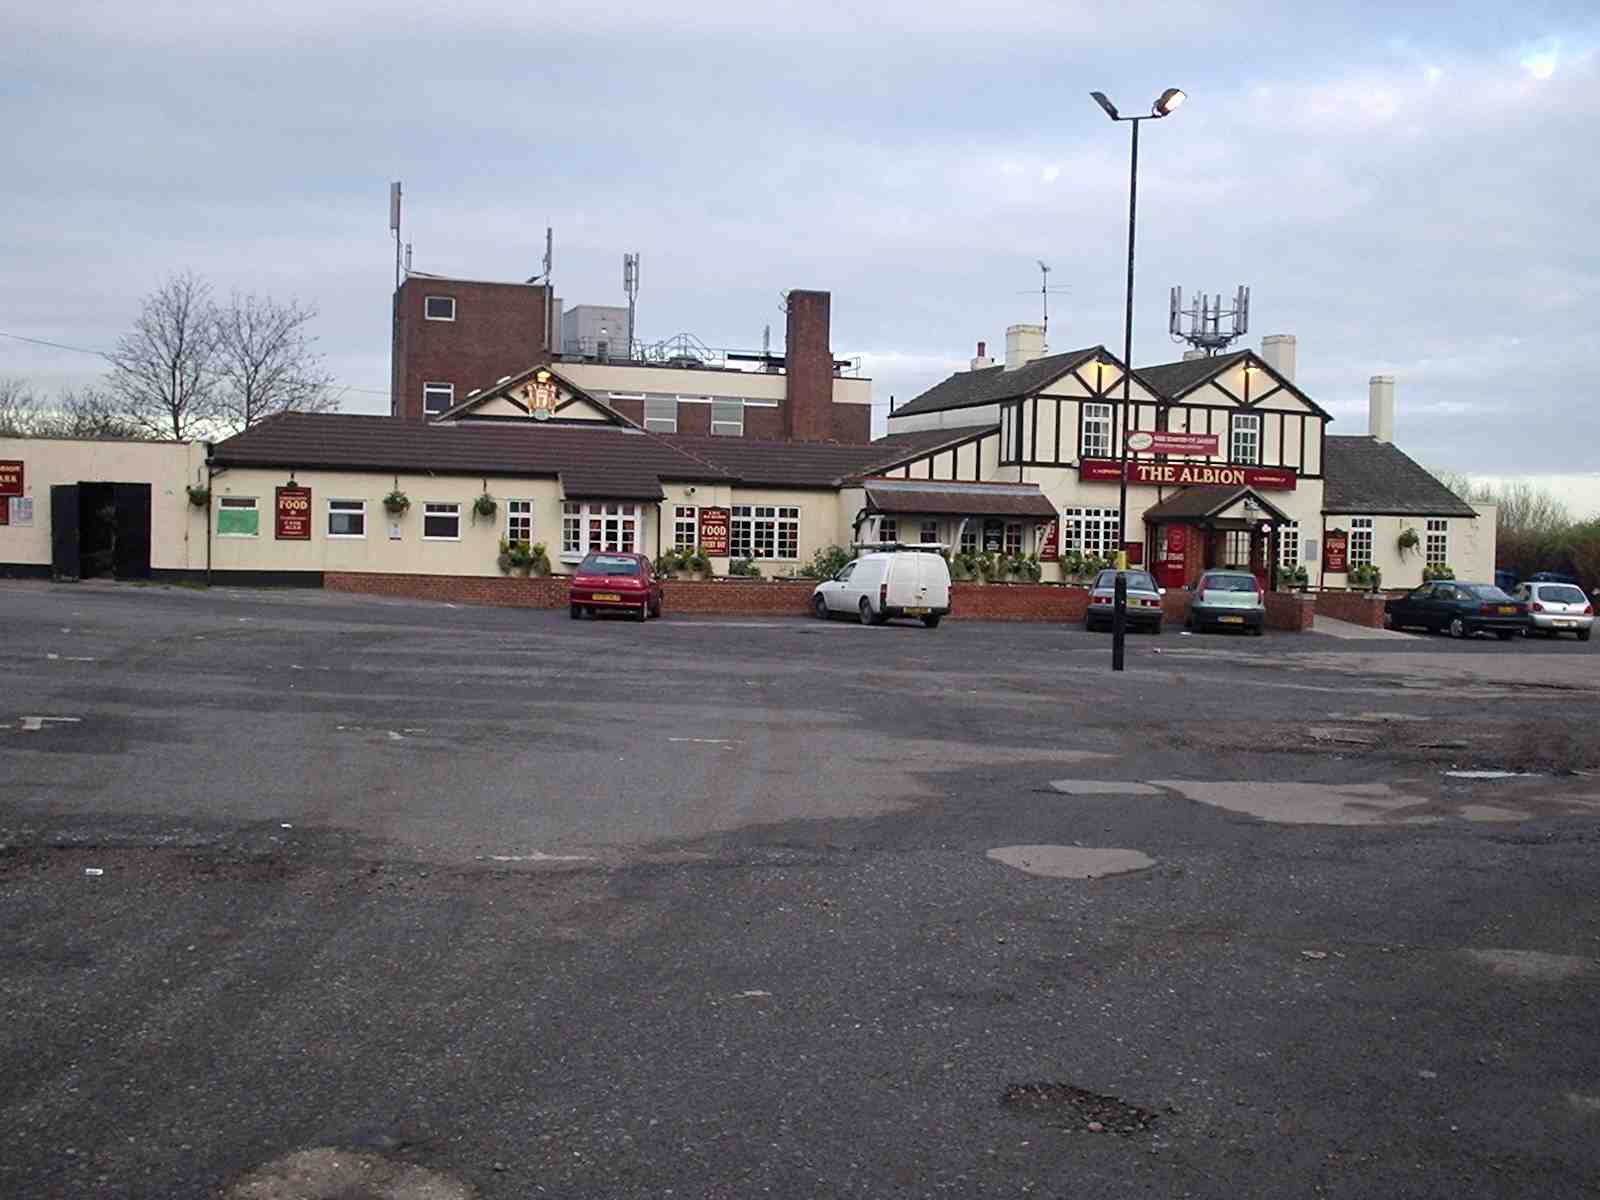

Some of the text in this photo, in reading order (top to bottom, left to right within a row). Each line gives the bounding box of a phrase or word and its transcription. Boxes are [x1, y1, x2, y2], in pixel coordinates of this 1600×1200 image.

[1136, 465, 1245, 485] THE ALBION
[279, 500, 308, 510] FOOD
[702, 525, 727, 536] FOOD
